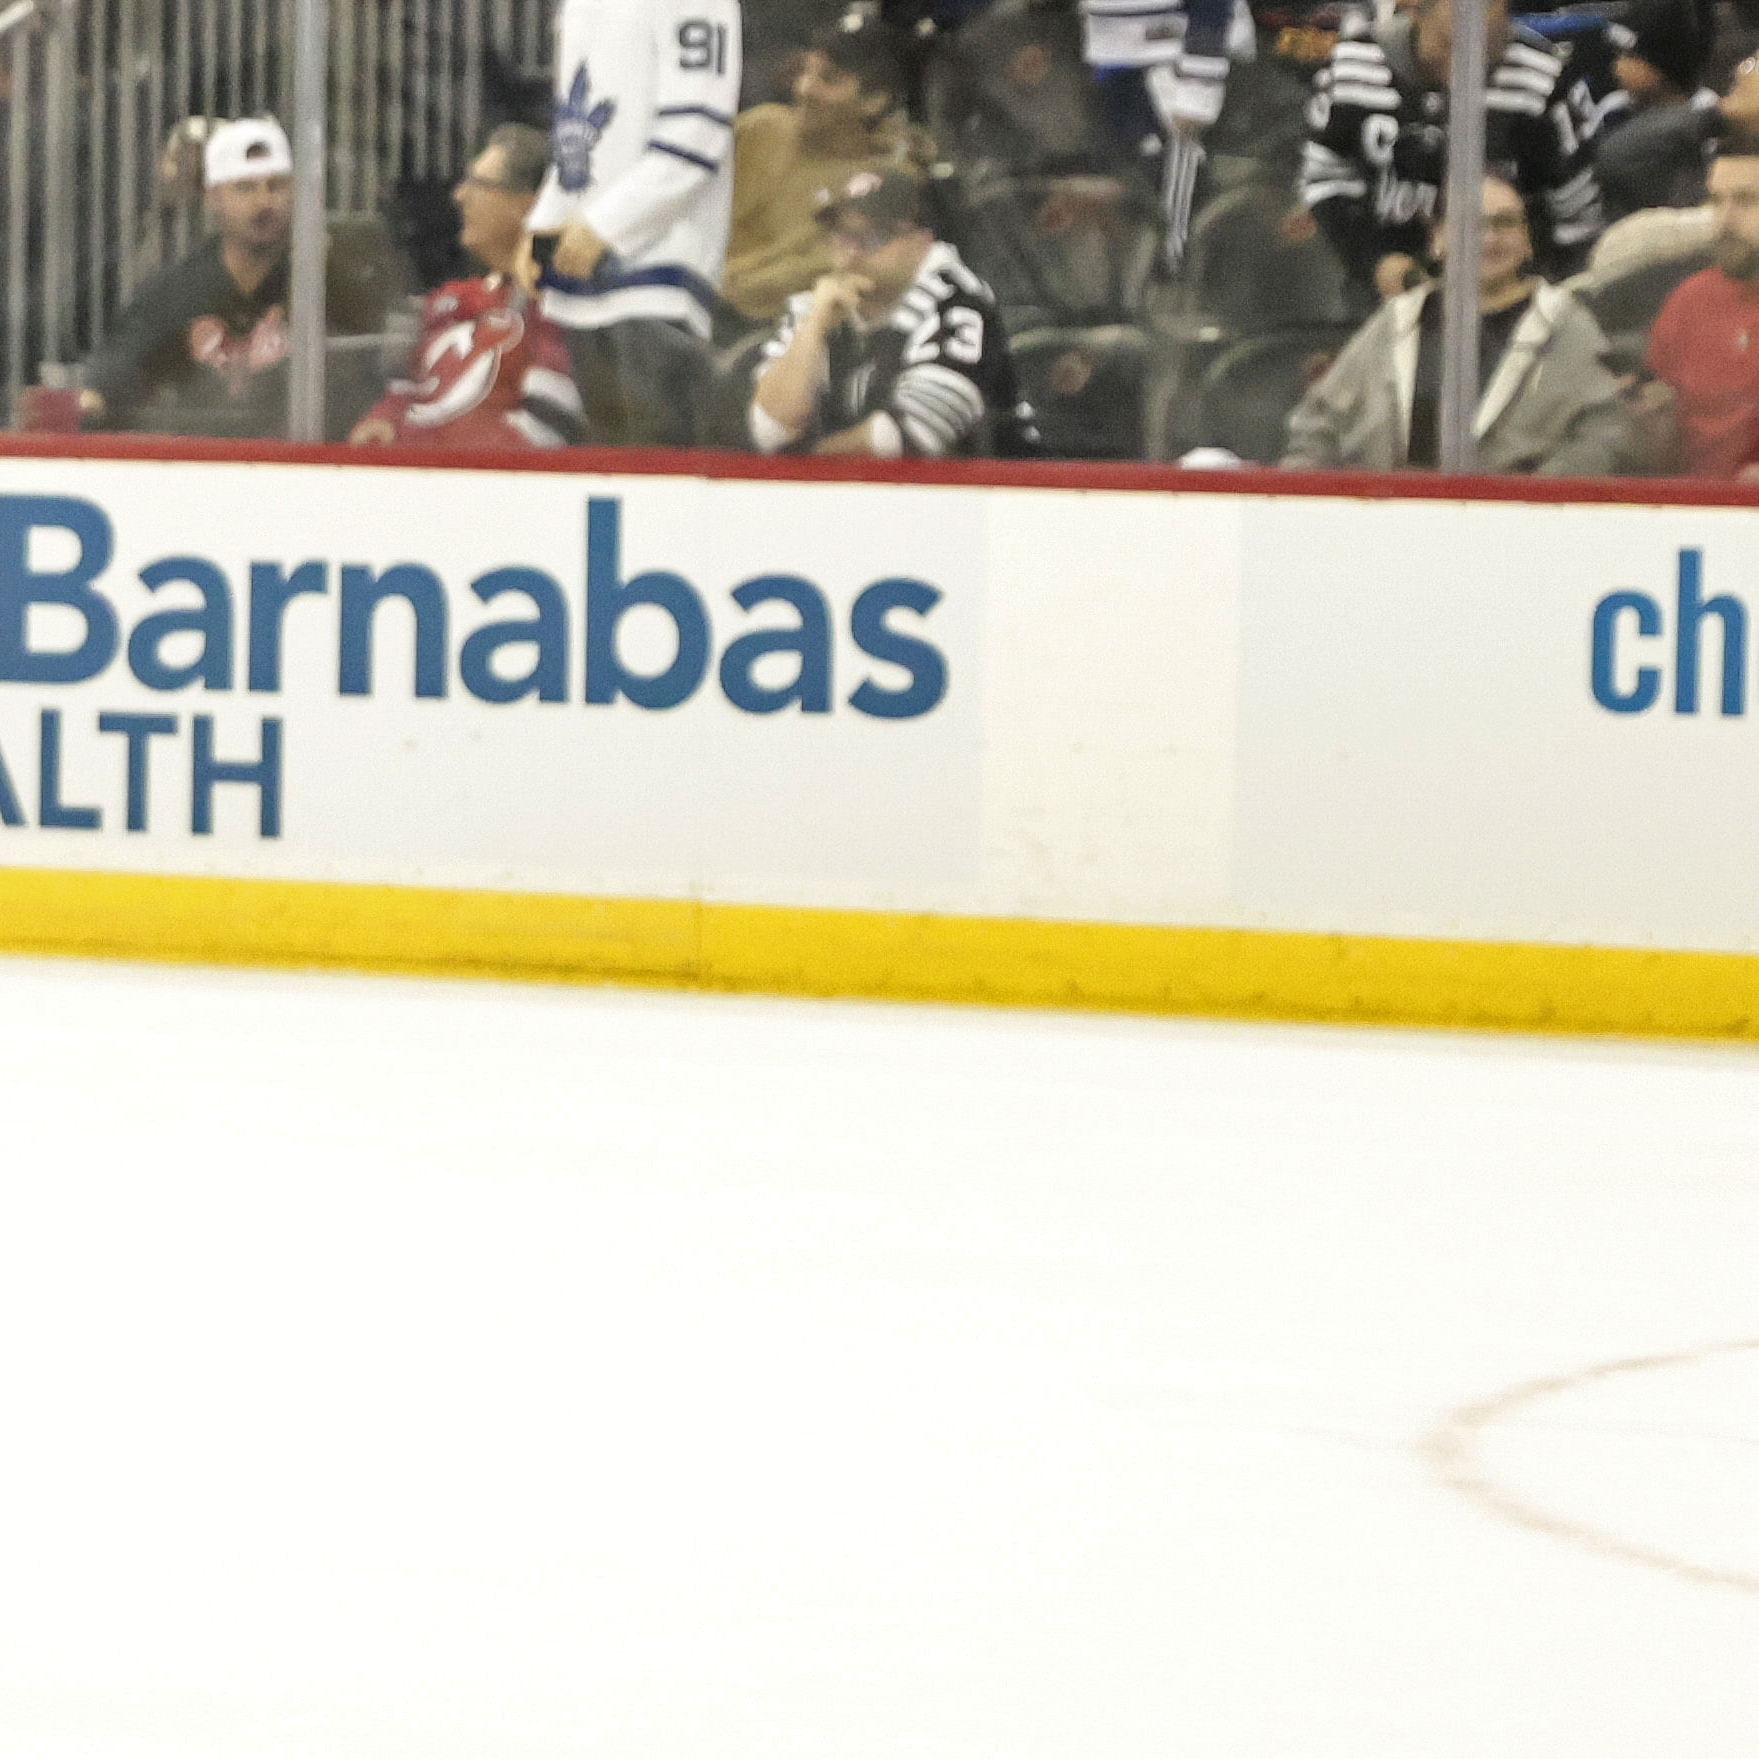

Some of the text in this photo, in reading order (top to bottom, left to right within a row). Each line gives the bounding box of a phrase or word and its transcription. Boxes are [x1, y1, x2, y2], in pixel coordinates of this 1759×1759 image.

[678, 20, 728, 78] 91
[905, 306, 984, 365] 23
[1590, 546, 1747, 717] ch
